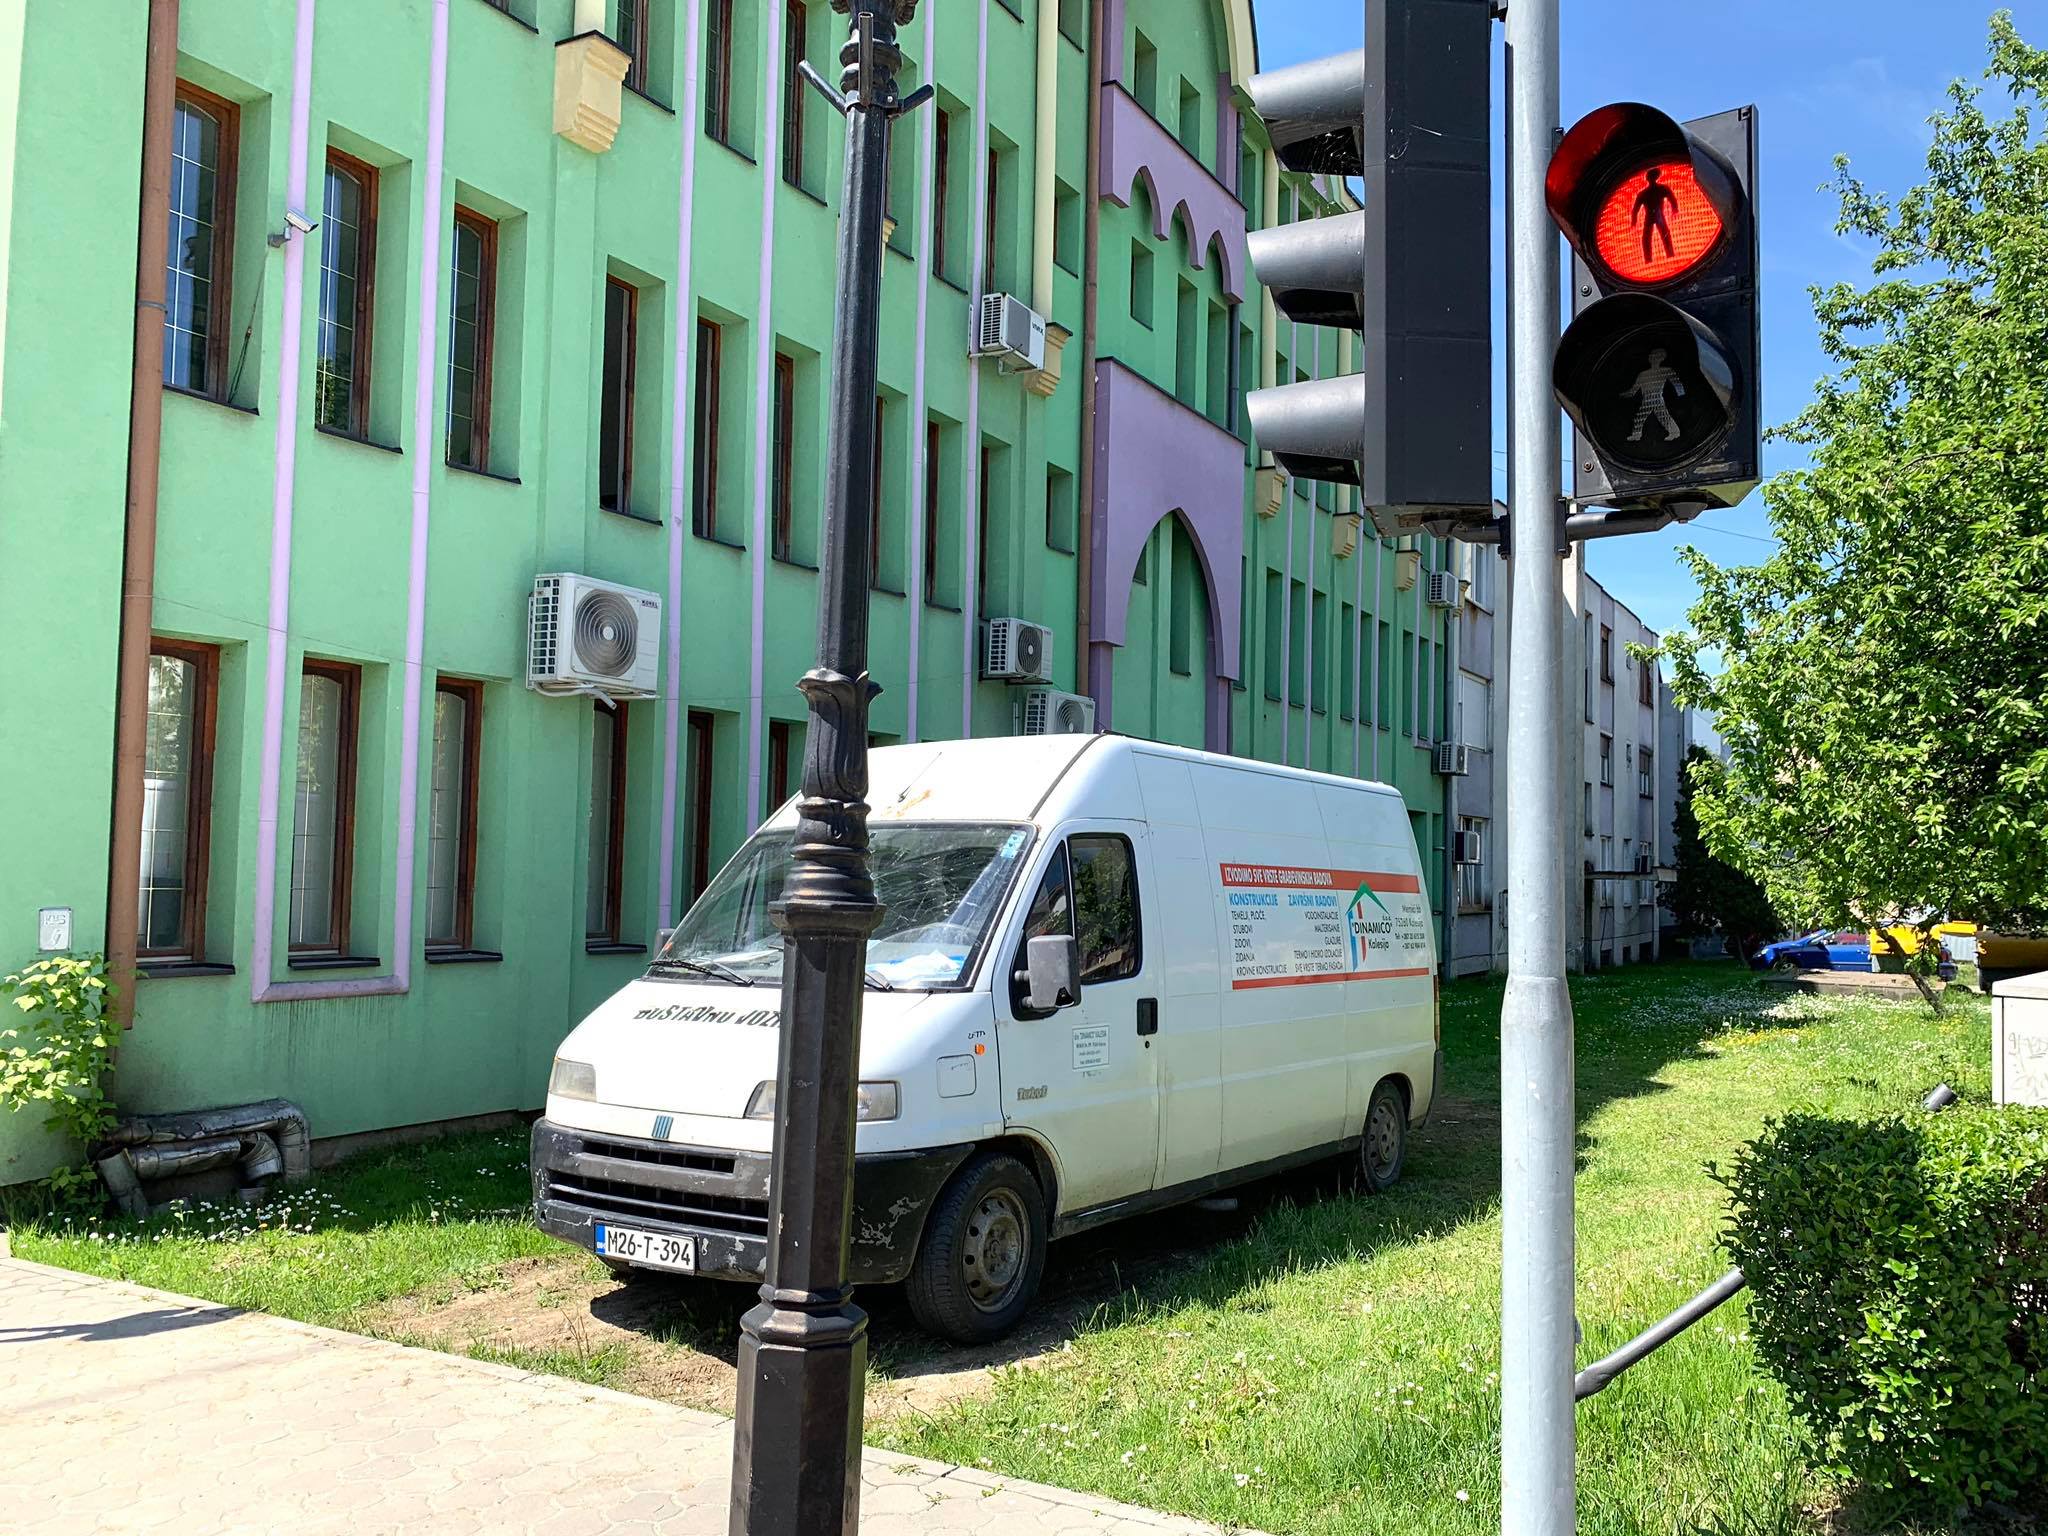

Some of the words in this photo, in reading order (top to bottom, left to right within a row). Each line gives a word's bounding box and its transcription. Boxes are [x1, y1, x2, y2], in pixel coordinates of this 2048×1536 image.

[1228, 893, 1279, 906] KONSTRUKCIJE
[1314, 894, 1338, 907] RADOVI
[607, 1230, 691, 1266] M26-T-394
